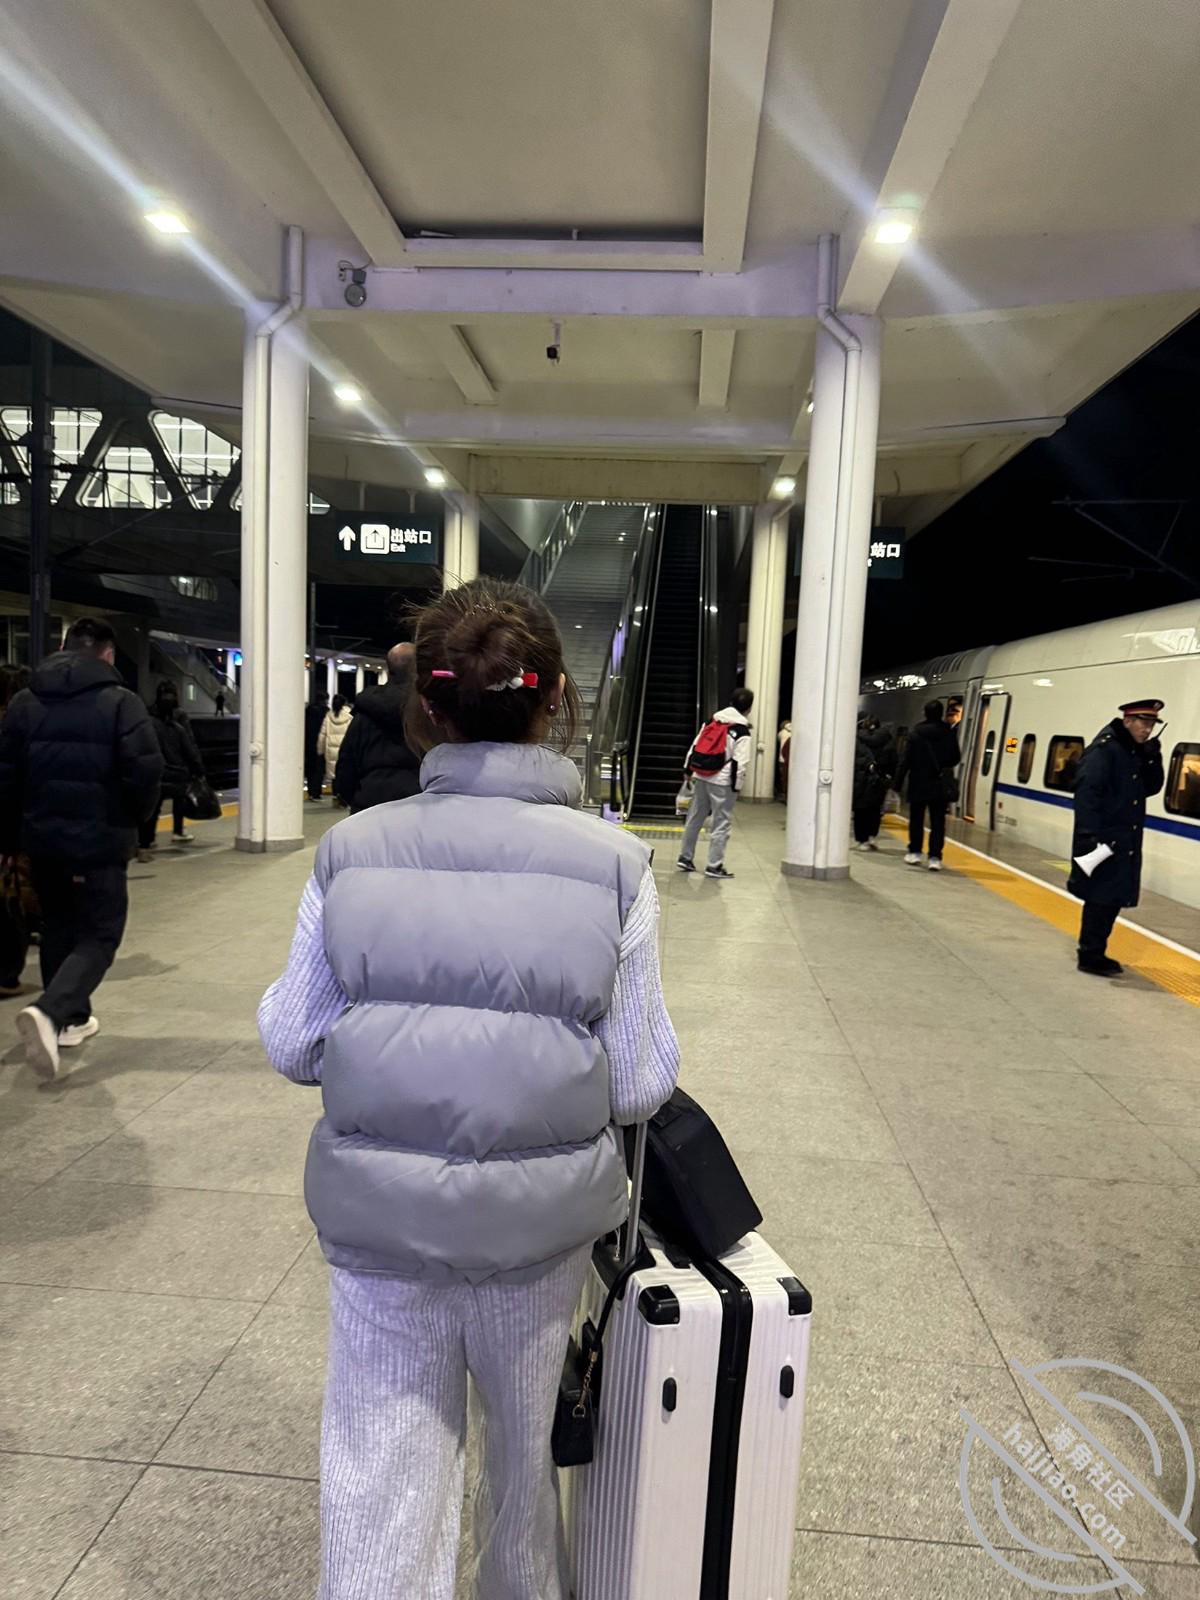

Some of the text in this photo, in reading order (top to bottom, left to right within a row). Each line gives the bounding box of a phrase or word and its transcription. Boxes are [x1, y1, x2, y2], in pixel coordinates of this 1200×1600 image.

[390, 528, 432, 544] 出站口
[870, 542, 901, 558] 站口
